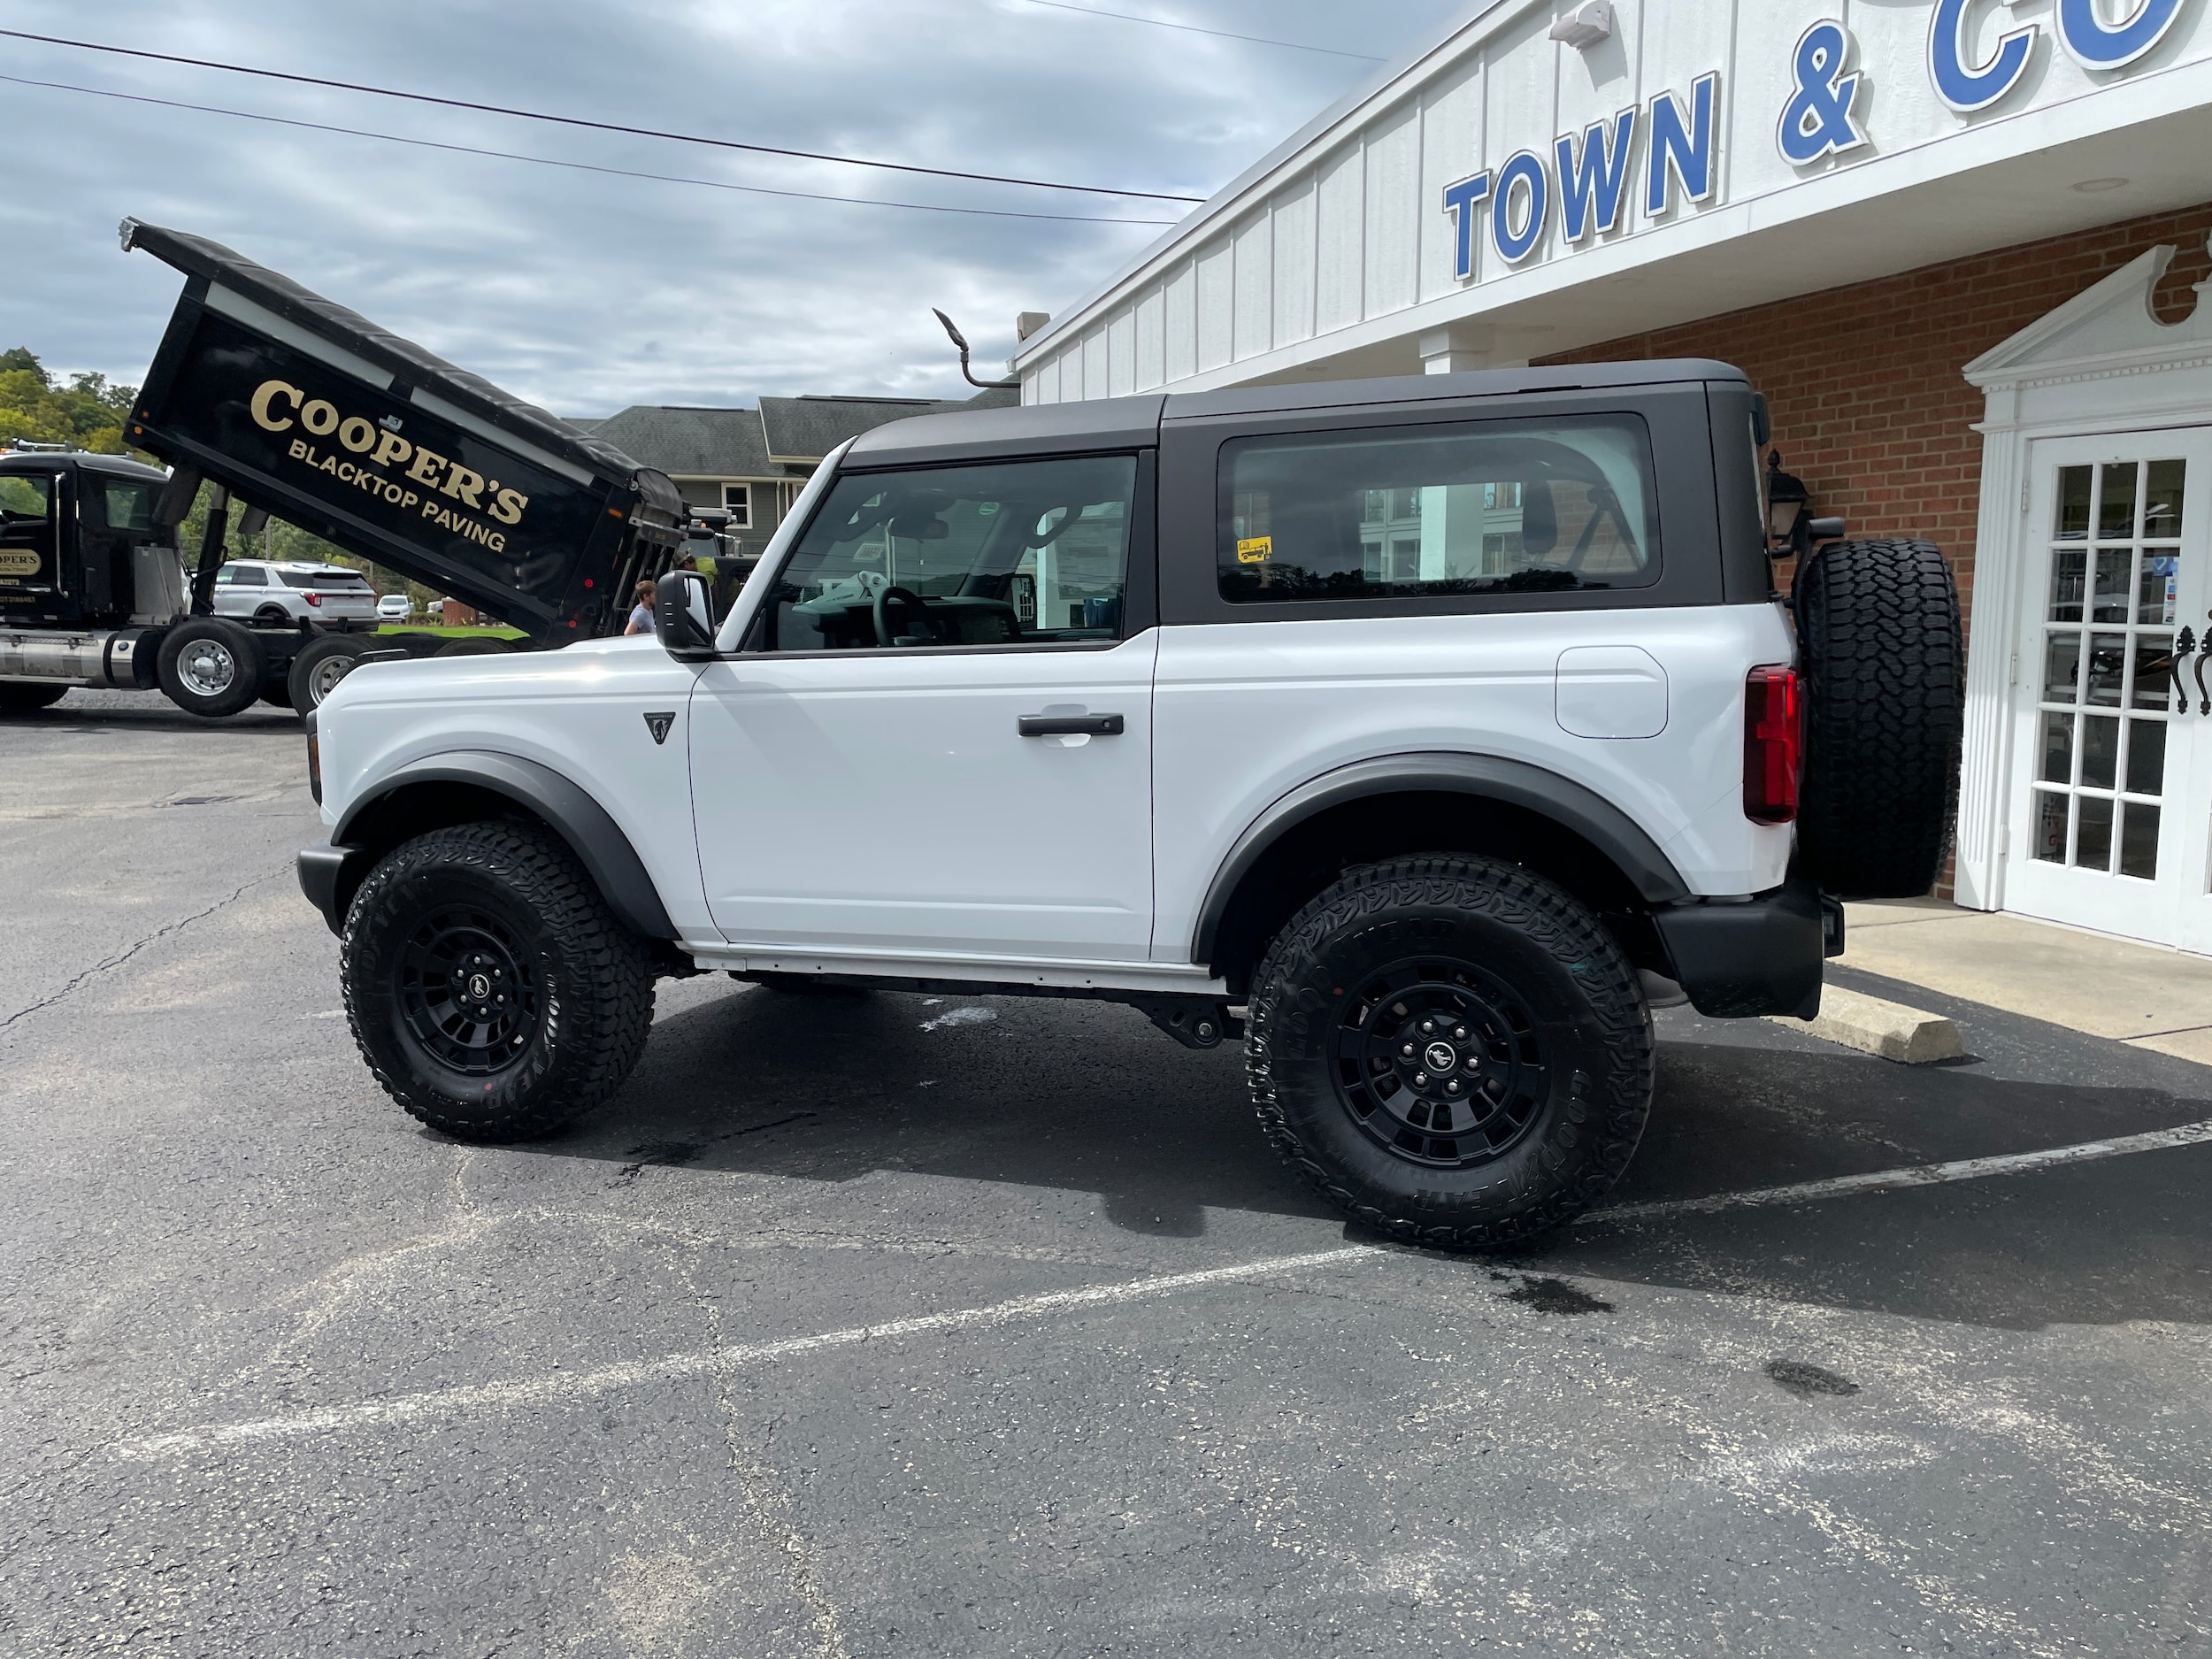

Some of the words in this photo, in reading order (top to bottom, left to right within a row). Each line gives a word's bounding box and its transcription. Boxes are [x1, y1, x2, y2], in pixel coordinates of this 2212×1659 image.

[1442, 70, 1719, 281] TOWN
[1777, 18, 1869, 166] &
[251, 380, 529, 525] COOPER'S
[288, 439, 419, 509] BLACKTOP
[421, 500, 506, 553] PAVING
[1412, 1069, 1593, 1214] GOODYEAR
